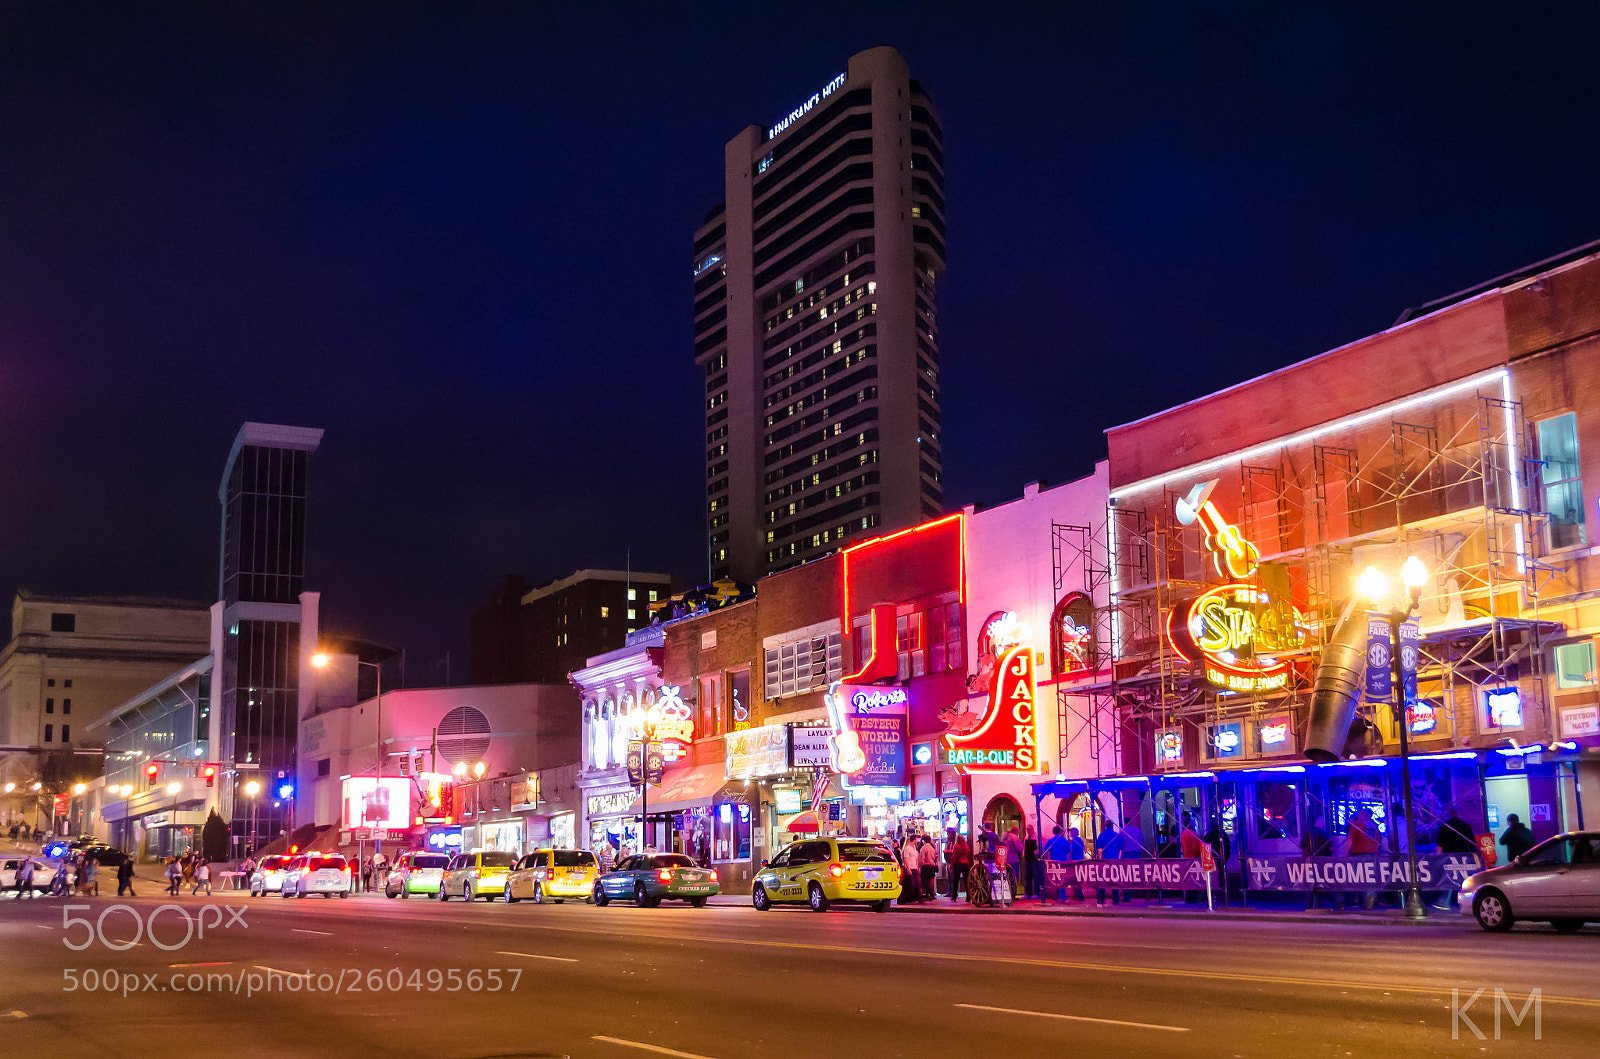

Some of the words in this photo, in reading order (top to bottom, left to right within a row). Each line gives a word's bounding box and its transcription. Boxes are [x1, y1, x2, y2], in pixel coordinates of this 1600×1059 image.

[768, 92, 820, 140] RENAISSANCE
[1368, 626, 1389, 636] FANS
[1399, 629, 1418, 639] FANS
[1370, 645, 1387, 667] SEC
[1401, 648, 1415, 667] SEC
[1206, 668, 1225, 685] ON
[1010, 655, 1035, 769] JACKS
[1564, 711, 1596, 721] STETSON
[851, 717, 901, 730] WESTERN
[807, 729, 834, 737] LAYLA'S
[860, 731, 901, 743] WORLD
[794, 743, 811, 751] DEAN
[865, 743, 896, 755] HOME
[947, 749, 1015, 765] BAR-B-QUE
[1531, 805, 1548, 814] ATM
[1074, 864, 1140, 883] WELCOME
[1144, 863, 1181, 883] FANS
[1286, 862, 1376, 883] WELCOME
